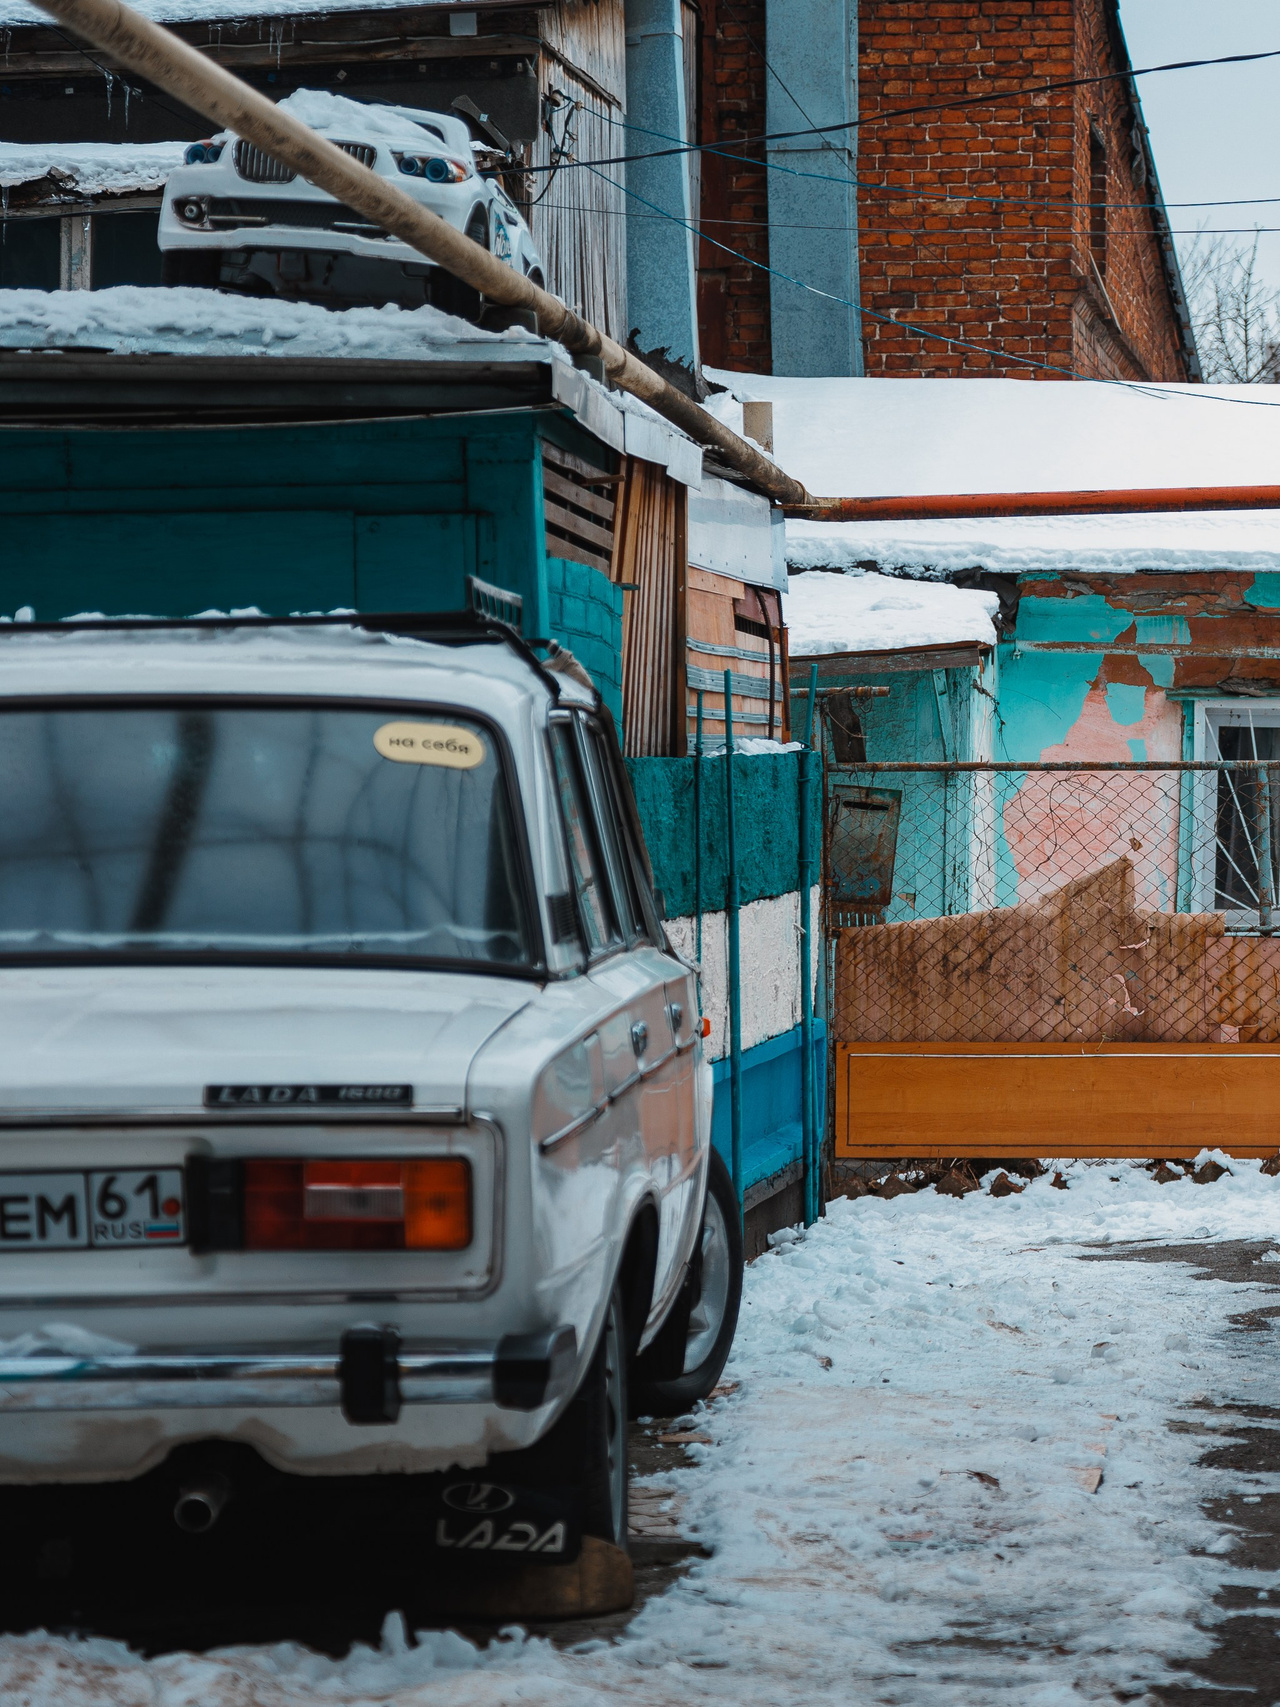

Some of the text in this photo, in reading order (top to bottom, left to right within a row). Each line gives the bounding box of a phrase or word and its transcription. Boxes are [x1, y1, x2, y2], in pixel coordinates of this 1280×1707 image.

[389, 737, 469, 754] на себя
[218, 1086, 321, 1102] LADA
[0, 1175, 160, 1240] EM 61
[94, 1222, 143, 1239] RUS
[436, 1518, 564, 1552] LADA
